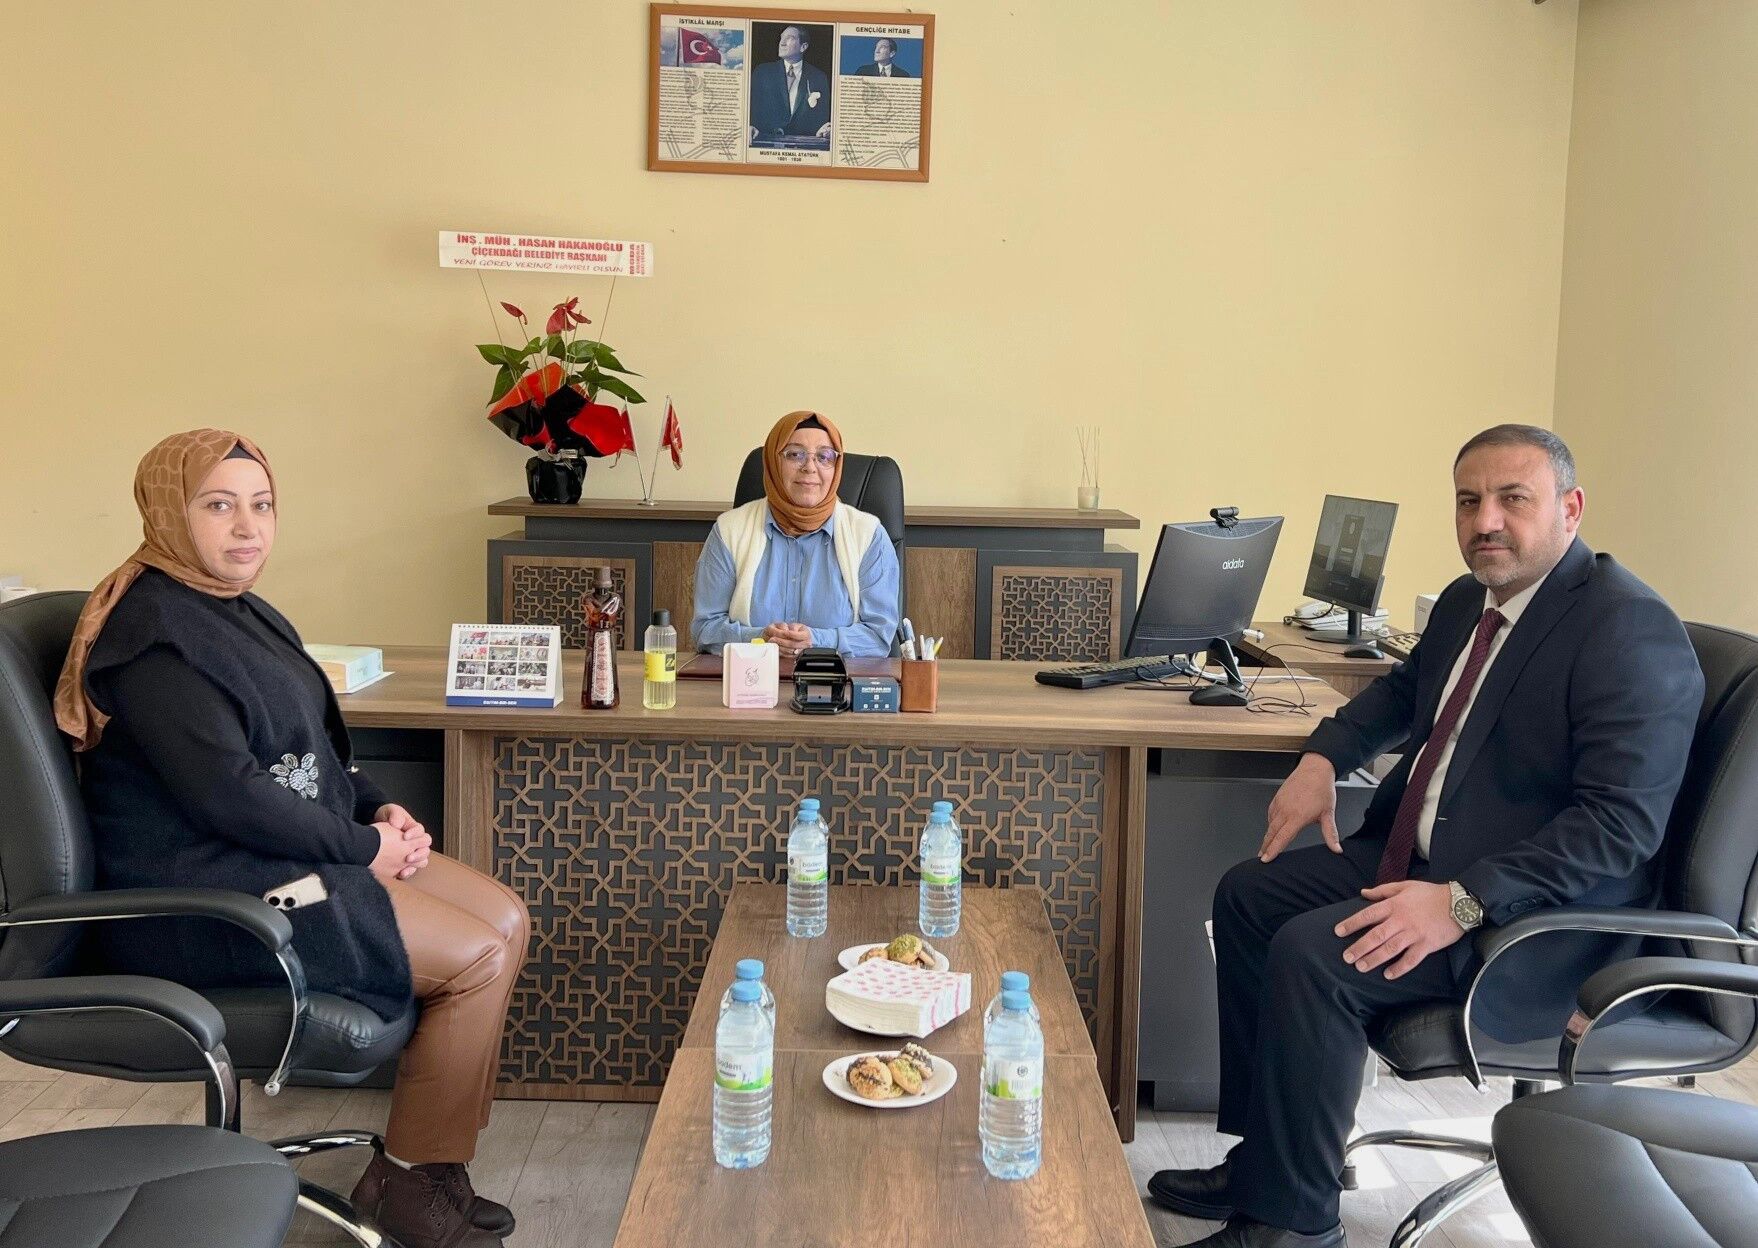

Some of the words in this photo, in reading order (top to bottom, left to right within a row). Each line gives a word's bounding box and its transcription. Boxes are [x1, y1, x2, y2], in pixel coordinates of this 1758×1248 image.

[518, 238, 556, 249] HASAN
[558, 240, 623, 252] HAKANOĞLU
[472, 247, 522, 258] ÇİÇEKDAĞI
[524, 250, 565, 260] BELEDİYE
[567, 252, 607, 262] BAŞKANI
[592, 265, 623, 273] OLSUN
[1222, 557, 1245, 570] aidata
